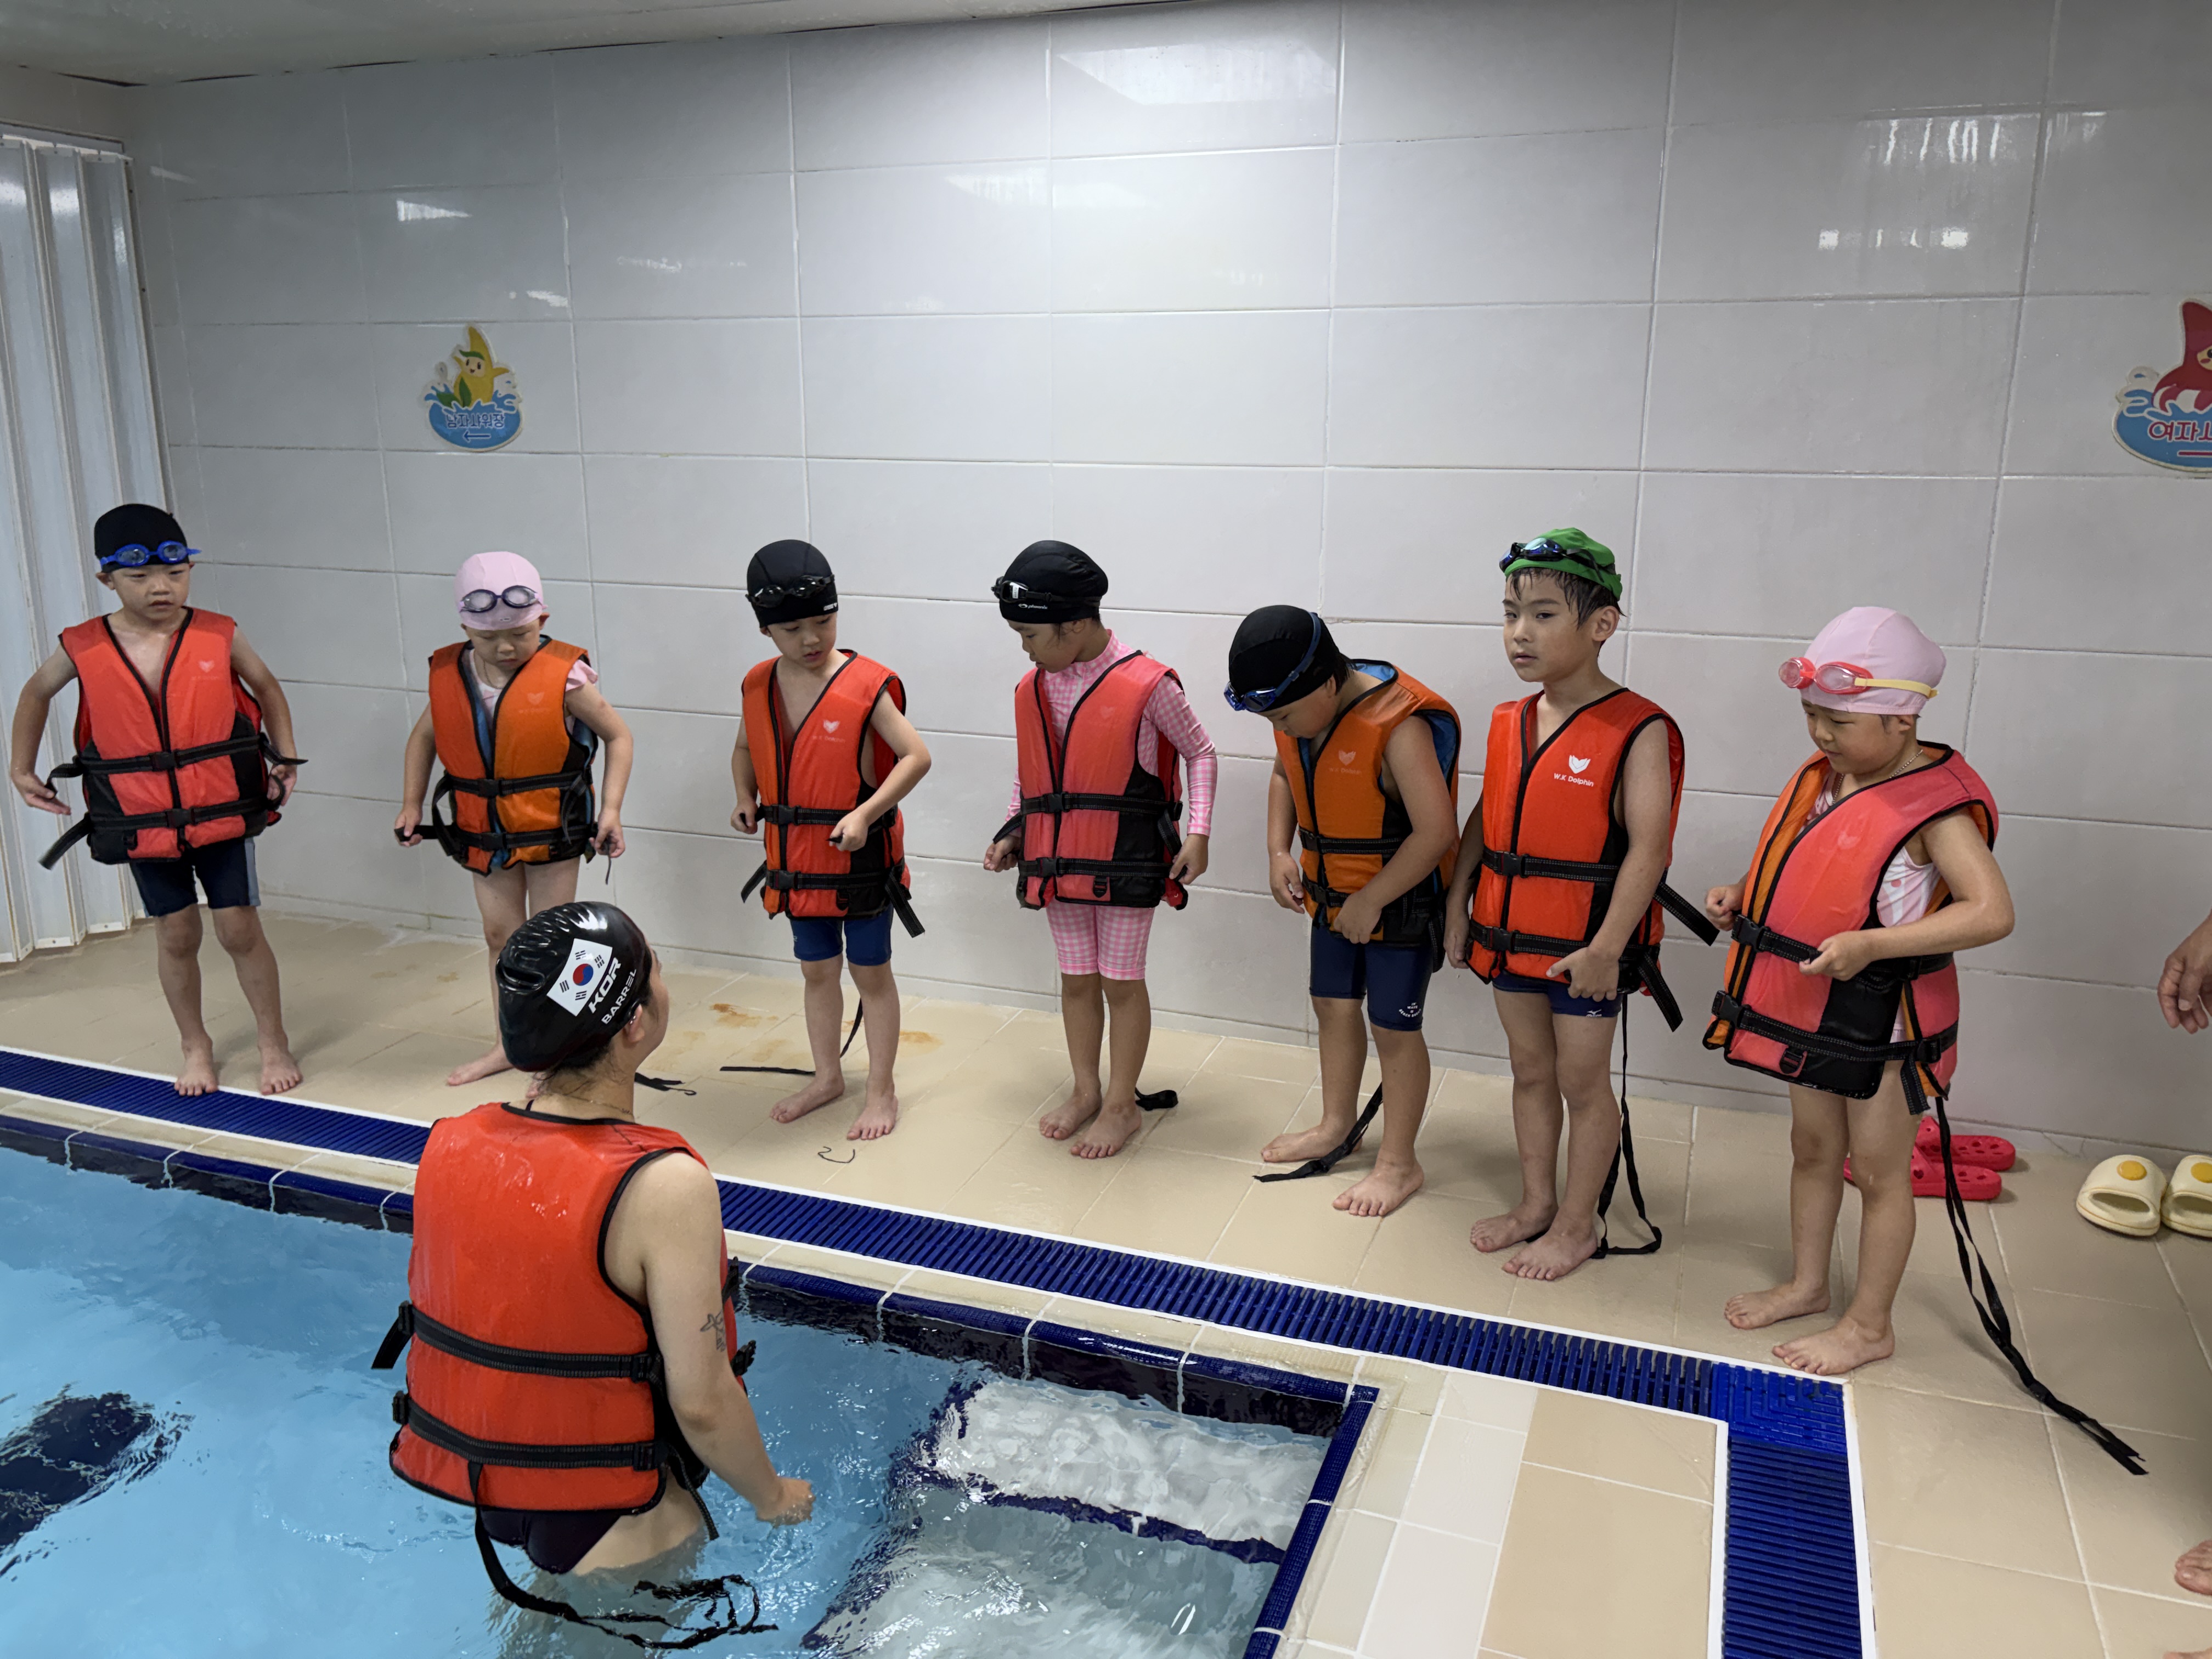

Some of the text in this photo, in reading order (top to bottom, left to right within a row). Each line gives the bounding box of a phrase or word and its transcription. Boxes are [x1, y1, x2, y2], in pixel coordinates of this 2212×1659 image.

[1554, 772, 1594, 787] W.K Dolphin
[588, 957, 621, 1014] KOR
[601, 969, 636, 1024] BARREL
